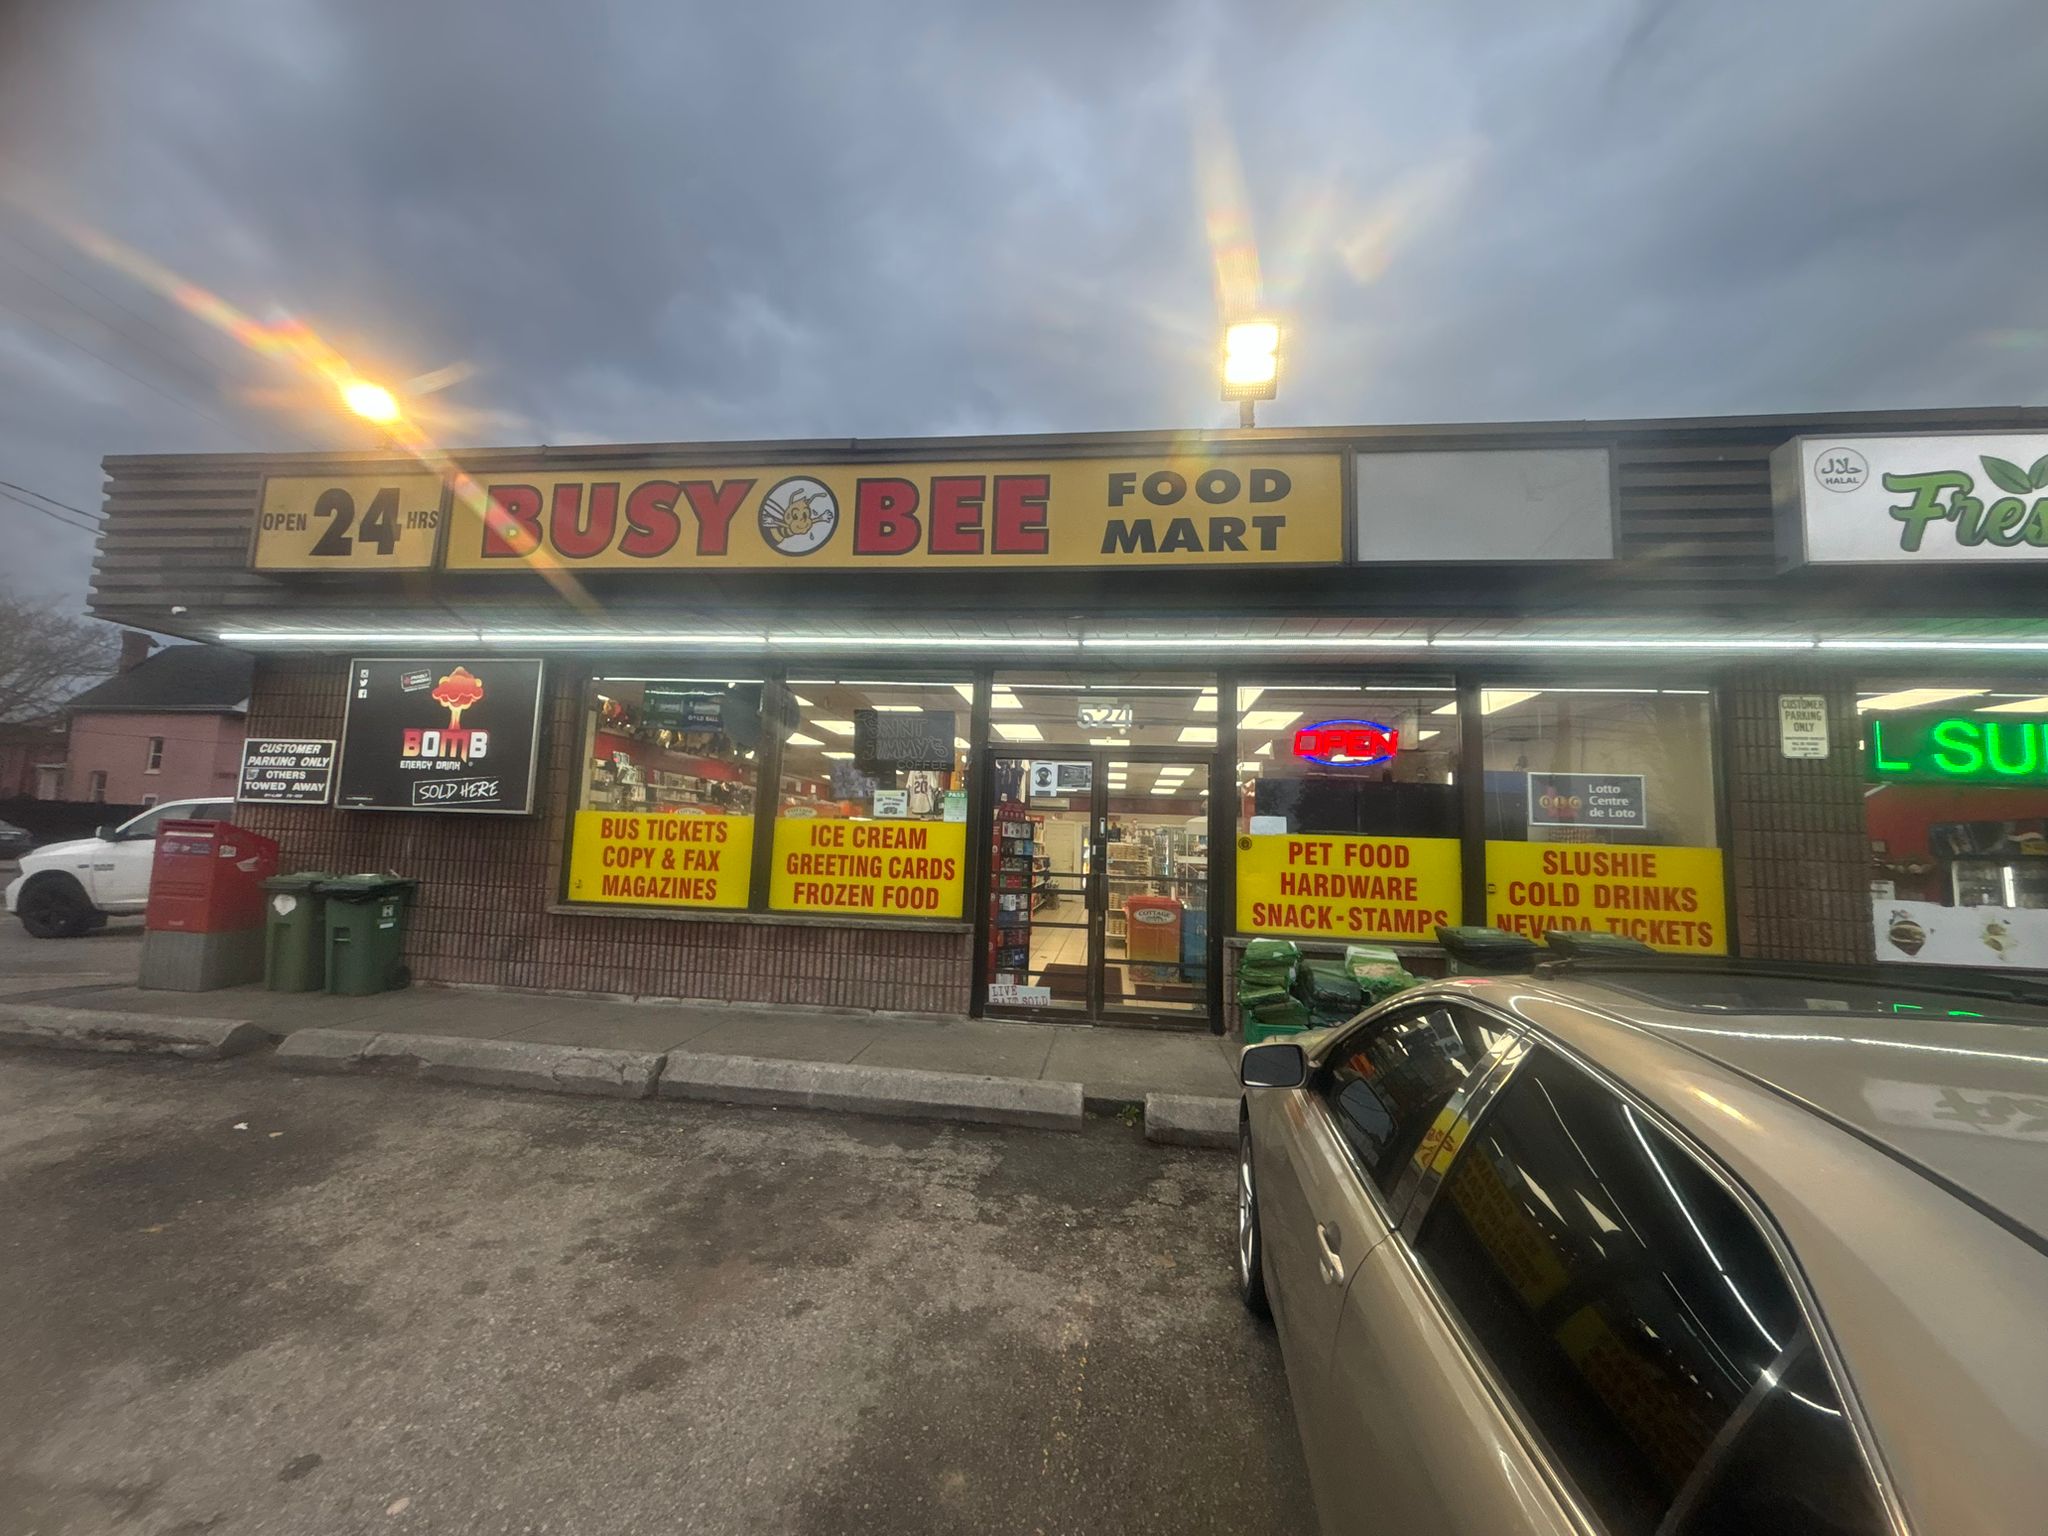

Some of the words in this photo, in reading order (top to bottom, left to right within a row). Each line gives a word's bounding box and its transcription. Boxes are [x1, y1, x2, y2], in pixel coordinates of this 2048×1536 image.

[1107, 468, 1293, 507] FOOD
[1825, 476, 1860, 485] HALAL
[263, 511, 307, 532] OPEN
[309, 487, 401, 557] 24
[407, 510, 438, 531] HRS
[481, 478, 758, 559] BUSY
[852, 474, 1051, 556] BEE
[1100, 515, 1286, 555] MART
[1077, 704, 1133, 729] 524
[1785, 710, 1822, 721] PARKING
[1793, 722, 1814, 732] ONLY
[260, 743, 322, 754] CUSTOMER
[402, 729, 488, 763] BOMB
[1294, 729, 1398, 757] OPEN
[1933, 718, 2048, 774] SU
[247, 756, 296, 767] PARKING
[300, 757, 330, 767] ONLY
[400, 760, 433, 771] ENERGY
[435, 761, 461, 771] DRINK
[897, 760, 947, 770] COFFEE
[244, 781, 287, 791] TOWED
[291, 782, 325, 792] AWAY
[266, 770, 306, 780] OTHERS
[914, 780, 929, 795] 20
[418, 783, 457, 801] SOLD
[460, 780, 499, 798] HERE
[1588, 783, 1621, 794] Lotto
[1588, 795, 1629, 806] Centre
[1589, 807, 1605, 818] de
[1608, 808, 1636, 818] Loto
[601, 818, 640, 840] BUS
[646, 819, 728, 843] TICKETS
[811, 825, 845, 847] ICE
[852, 826, 928, 850] CREAM
[602, 846, 656, 870] COPY
[661, 848, 675, 870] &
[683, 849, 721, 872] FAX
[786, 852, 882, 878] GREETING
[888, 856, 956, 881] CARDS
[1288, 841, 1333, 866] PET
[1344, 844, 1410, 868] FOOD
[1543, 850, 1657, 878] SLUSHIE
[601, 875, 717, 900] MAGAZINES
[793, 882, 874, 907] FROZEN
[882, 886, 939, 909] FOOD
[1280, 872, 1418, 901] HARDWARE
[1509, 881, 1580, 906] COLD
[1594, 884, 1698, 913] DRINKS
[1497, 914, 1592, 939] NEVADA
[1605, 917, 1713, 948] TICKETS
[991, 986, 1018, 996] LIVE
[1022, 995, 1048, 1006] SOLD
